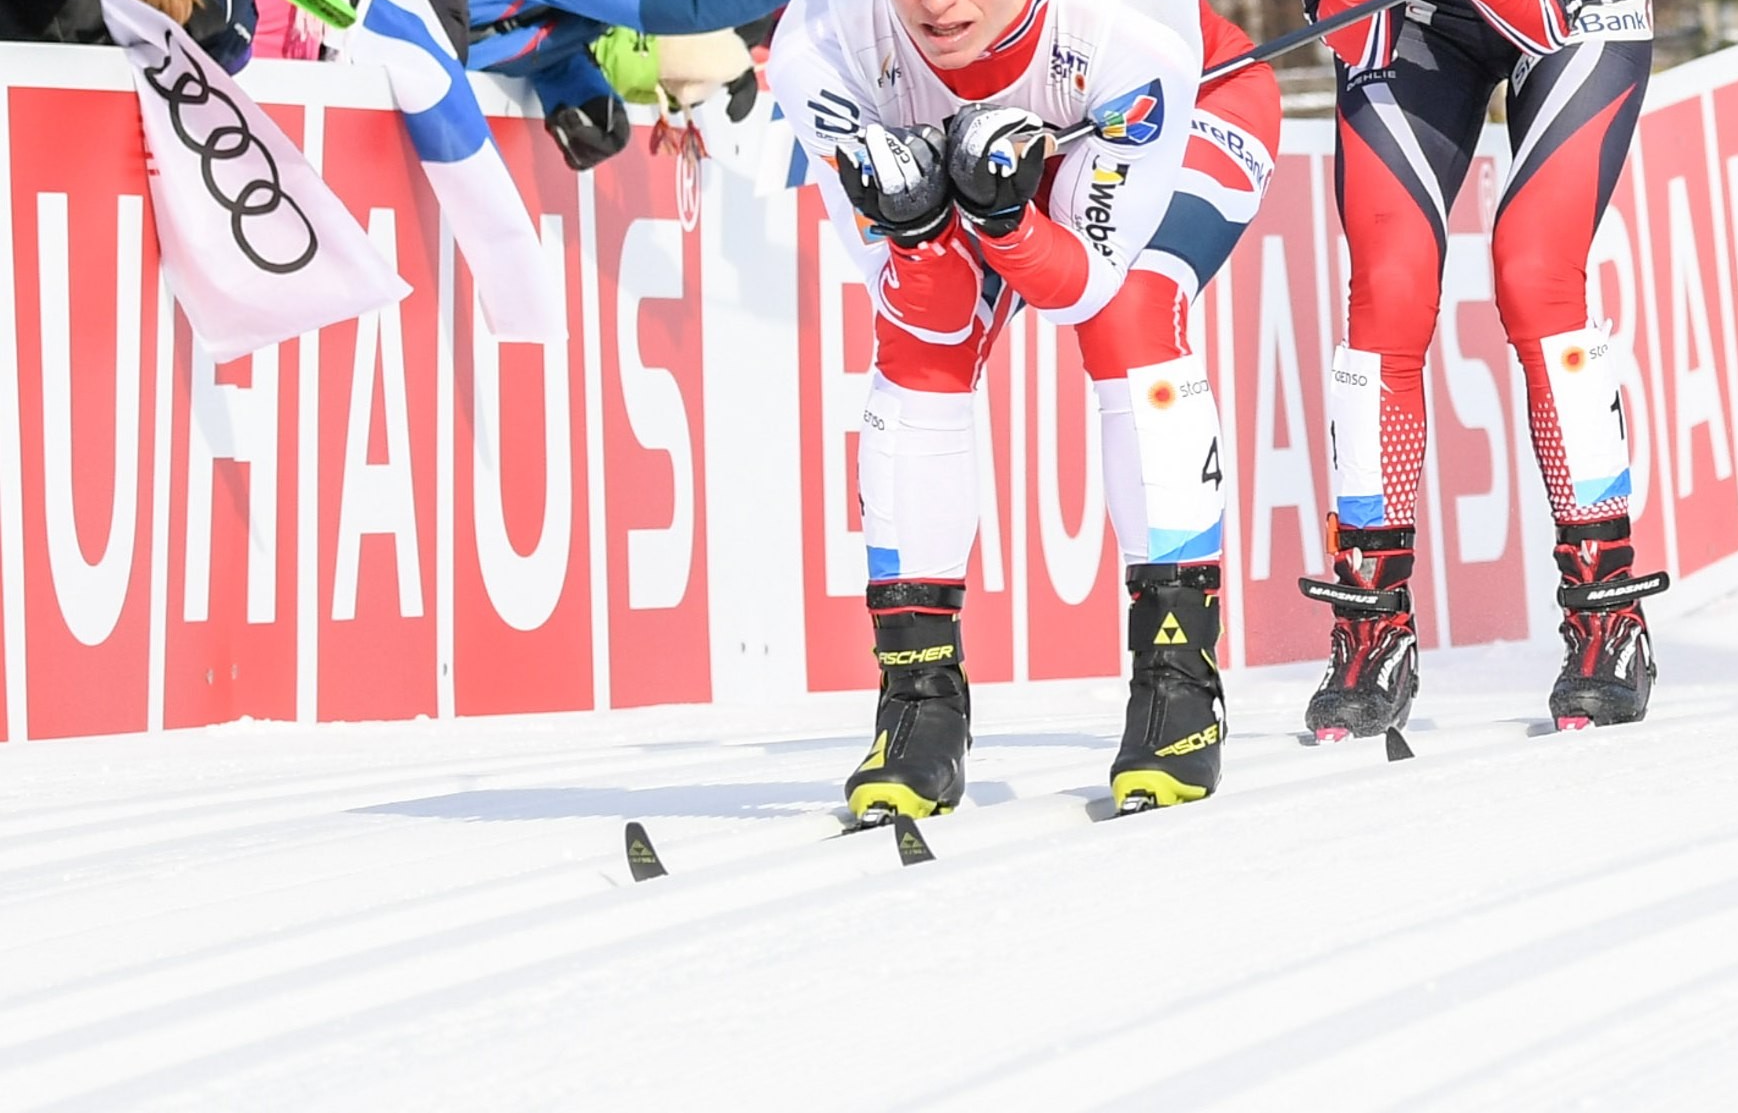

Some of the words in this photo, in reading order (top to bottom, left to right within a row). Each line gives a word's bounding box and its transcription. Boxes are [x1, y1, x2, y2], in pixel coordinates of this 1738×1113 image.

[886, 134, 911, 164] CRA
[1085, 183, 1117, 266] webe
[1610, 389, 1625, 440] 1
[1201, 435, 1223, 492] 4
[1309, 586, 1379, 605] MADSHUS
[1586, 578, 1660, 602] MADSHUS
